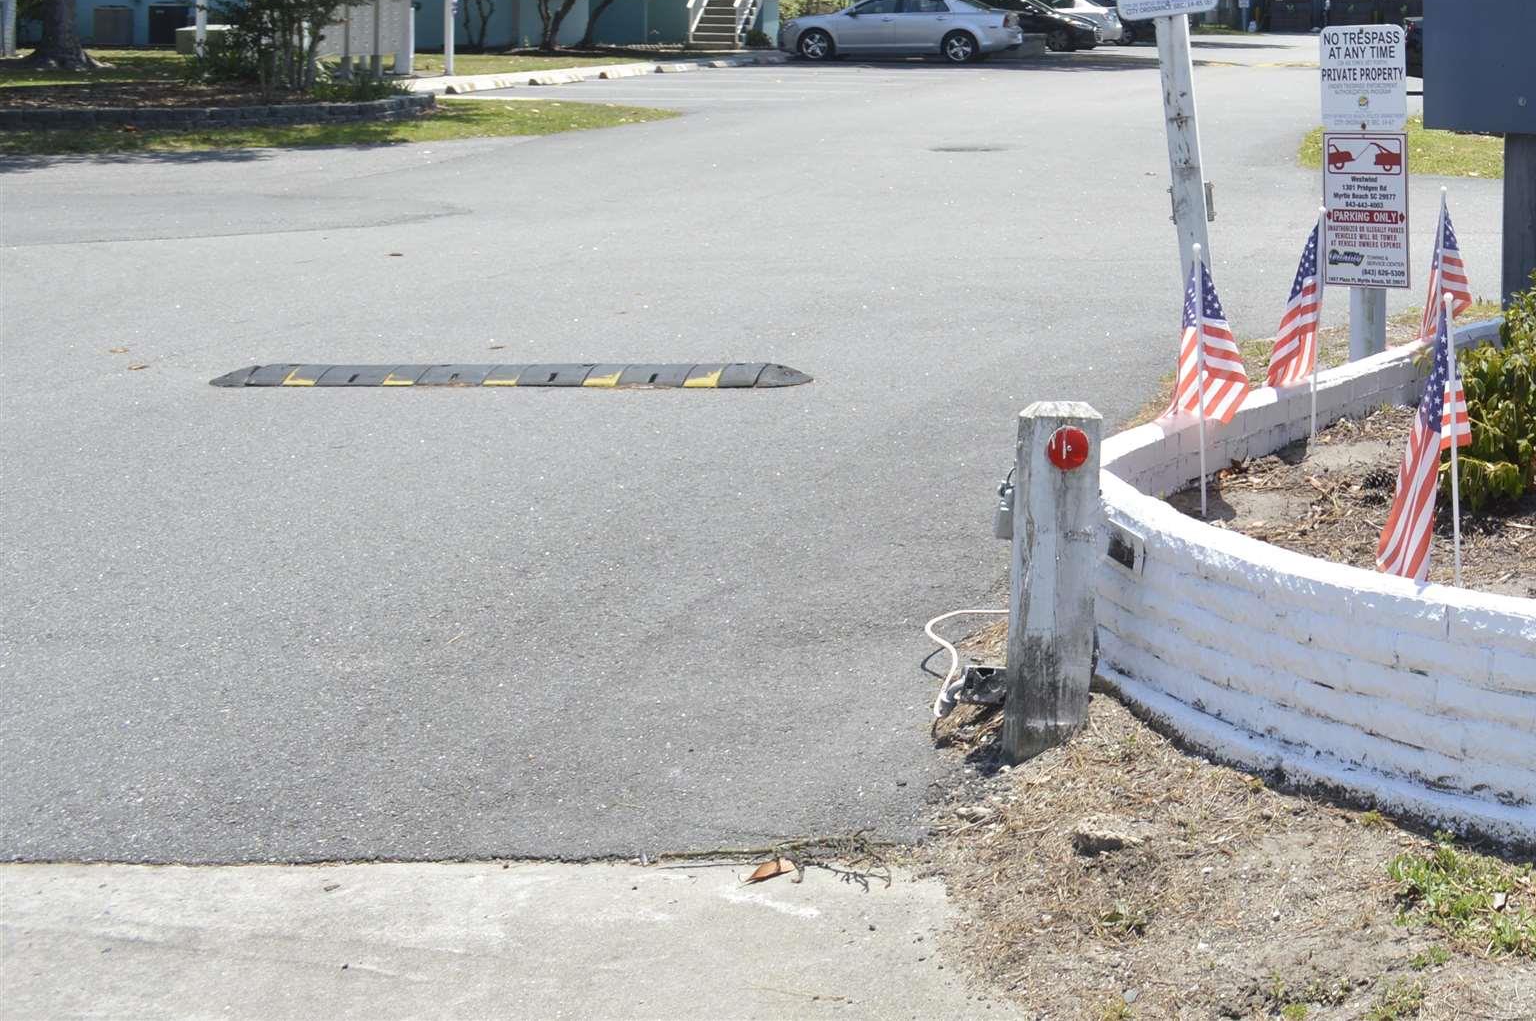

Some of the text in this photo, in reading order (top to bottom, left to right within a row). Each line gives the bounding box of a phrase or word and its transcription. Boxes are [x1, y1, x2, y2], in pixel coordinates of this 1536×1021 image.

[1324, 31, 1400, 45] NO TRESPASS
[1329, 46, 1395, 59] AT ANY TIME
[1321, 67, 1403, 81] PRIVATE PROPERTY
[1334, 211, 1397, 222] PARKING ONLY
